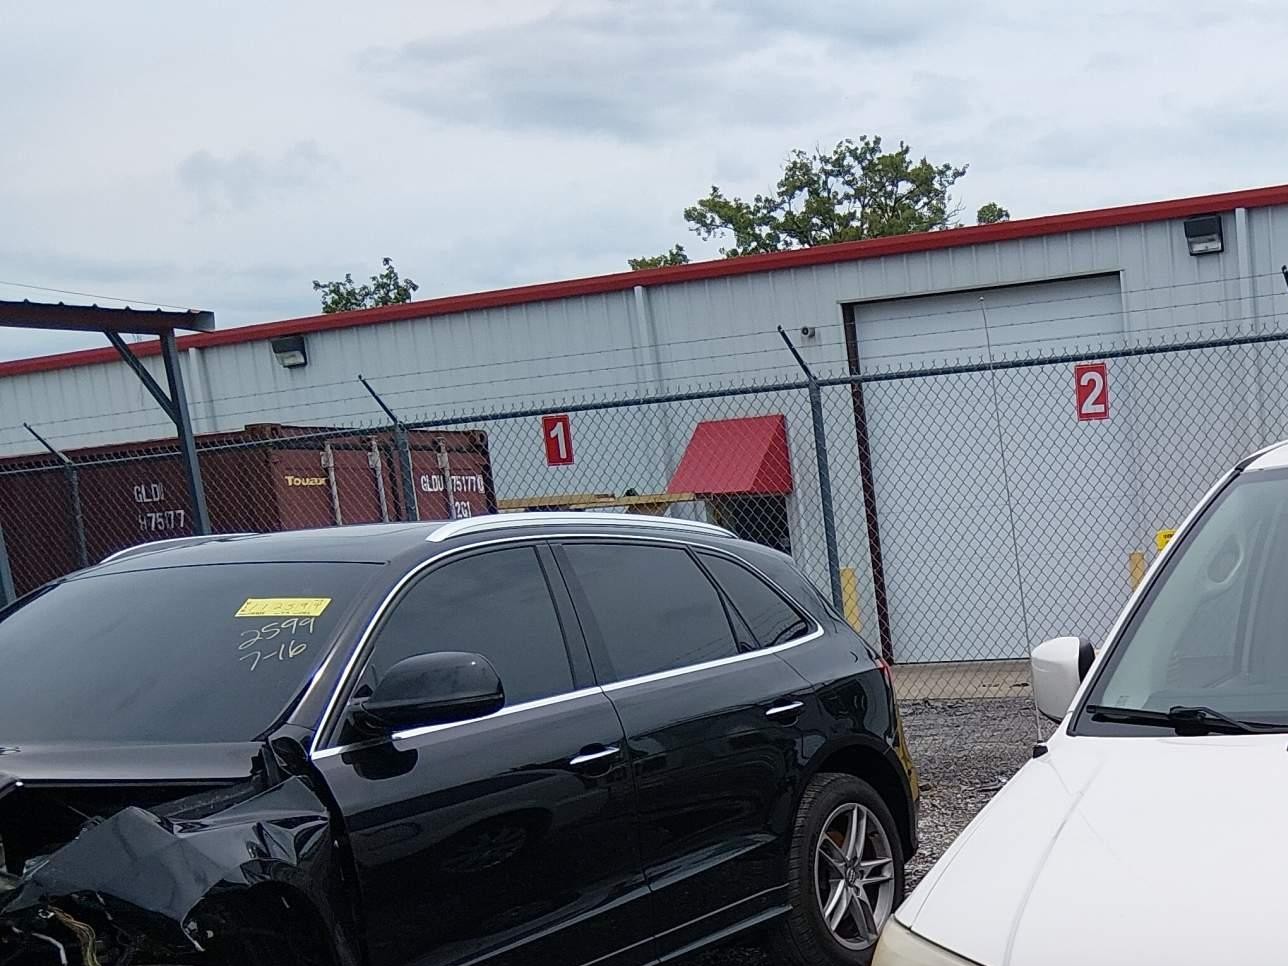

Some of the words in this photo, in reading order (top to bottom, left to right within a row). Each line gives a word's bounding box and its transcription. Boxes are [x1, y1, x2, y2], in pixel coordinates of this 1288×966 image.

[1080, 371, 1104, 414] 2
[550, 421, 567, 459] 1
[421, 475, 444, 492] GLDU
[239, 617, 315, 650] 2599
[240, 640, 307, 671] 7-16
